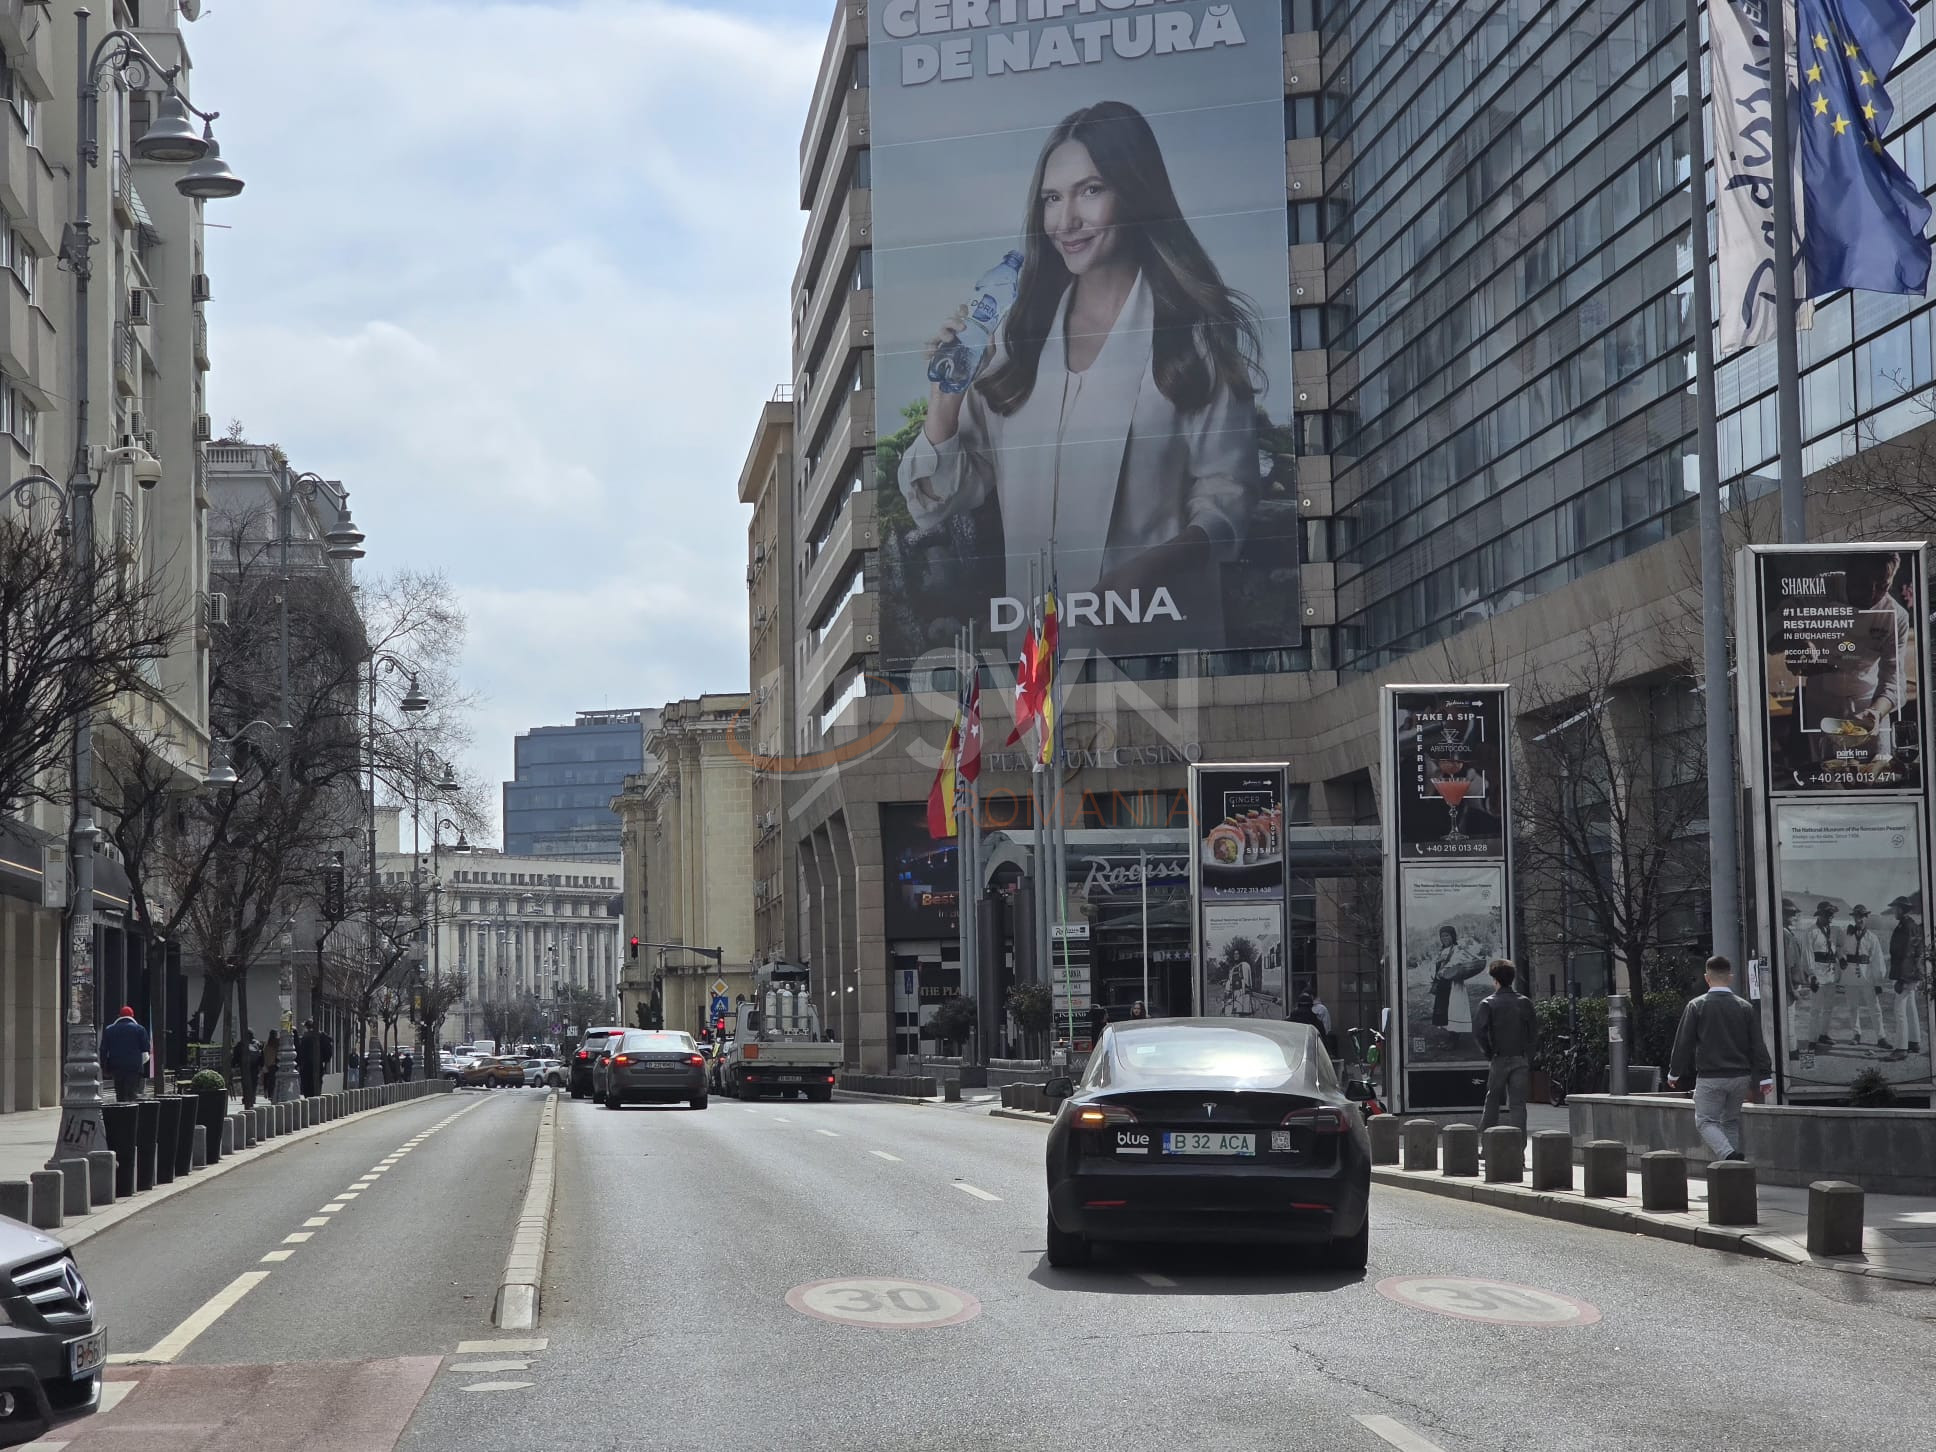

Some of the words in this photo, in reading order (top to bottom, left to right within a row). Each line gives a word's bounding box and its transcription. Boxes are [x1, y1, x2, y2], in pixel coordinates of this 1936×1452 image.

[901, 38, 974, 86] DE
[986, 3, 1247, 76] NATURĂ
[1781, 577, 1826, 596] SHARKIA
[1783, 609, 1794, 617] #1
[1796, 607, 1853, 616] LEBANESE
[1783, 619, 1855, 629] RESTAURANT
[1784, 648, 1821, 657] according
[1416, 713, 1442, 721] TAKE
[988, 750, 1100, 773] PLAUM
[1113, 742, 1203, 767] CASINO
[1416, 724, 1424, 792] REFRESH
[1836, 749, 1854, 757] park
[1809, 773, 1832, 783] +40
[1834, 773, 1853, 783] 216
[1856, 773, 1875, 782] 013
[1878, 772, 1896, 782] 471
[1427, 844, 1443, 852] +40
[1474, 843, 1487, 851] 428
[1080, 848, 1190, 899] Radiss
[920, 986, 940, 996] THE
[1117, 1132, 1150, 1145] blue
[1175, 1135, 1187, 1149] B
[1192, 1135, 1210, 1149] 32
[1219, 1135, 1249, 1150] ACA
[824, 1287, 942, 1313] 30
[1414, 1286, 1558, 1311] 30
[77, 1344, 84, 1369] B
